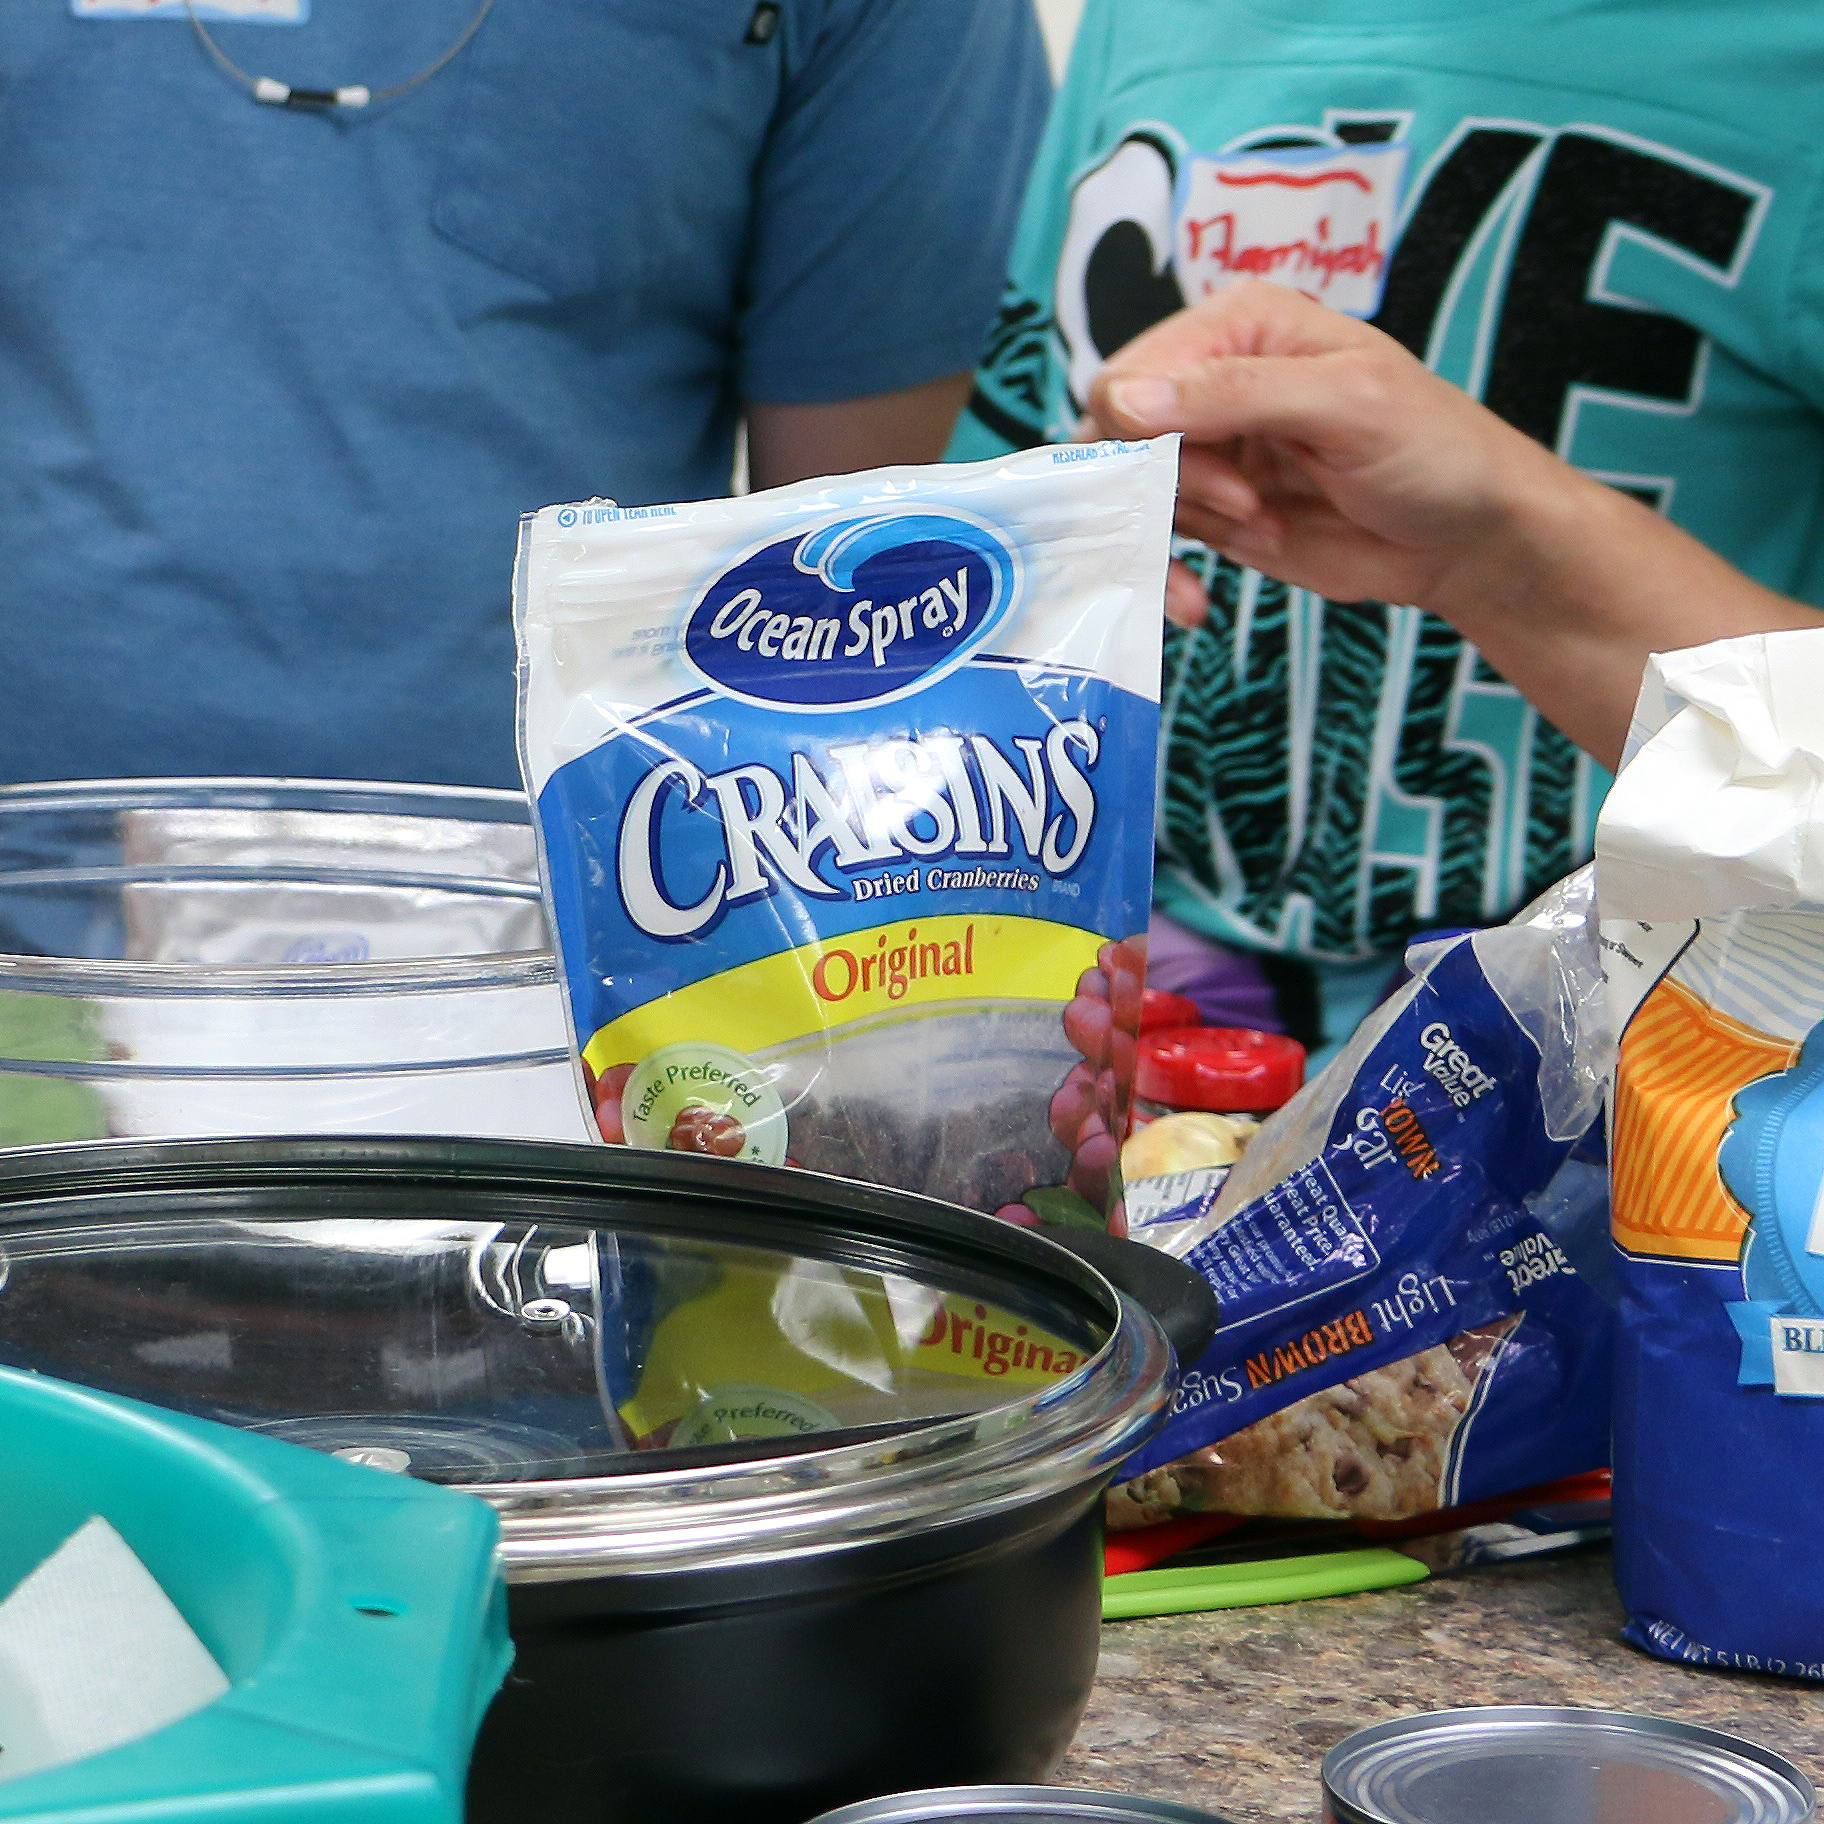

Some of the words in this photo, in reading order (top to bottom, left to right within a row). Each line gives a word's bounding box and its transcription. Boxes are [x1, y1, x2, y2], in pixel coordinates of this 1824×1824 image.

[708, 586, 842, 662] Ocean
[844, 565, 970, 668] Spray
[618, 715, 1102, 945] CRAISINS
[854, 866, 920, 904] Dried
[926, 865, 1040, 894] Cranberries
[812, 923, 974, 1002] Original
[1420, 1022, 1498, 1099] Great
[1423, 1052, 1471, 1107] Value
[633, 1079, 666, 1122] Taste
[666, 1061, 762, 1107] Preferred
[1300, 1165, 1329, 1206] reat
[1263, 1191, 1320, 1272] uaranteed.
[1371, 1272, 1458, 1333] Light
[1245, 1310, 1374, 1389] BROWN
[1168, 1366, 1243, 1418] Suga
[1648, 1620, 1684, 1650] NET
